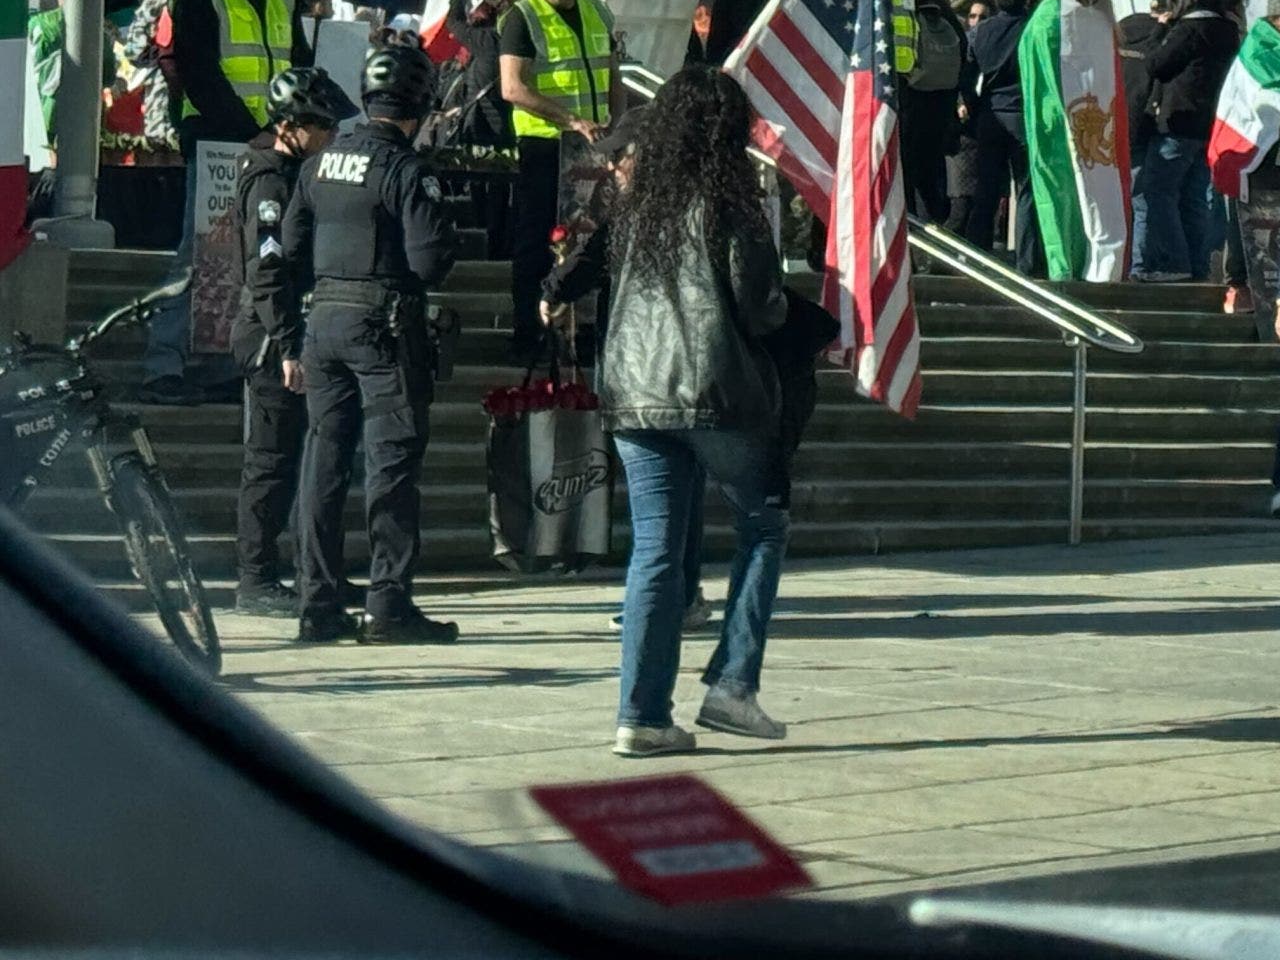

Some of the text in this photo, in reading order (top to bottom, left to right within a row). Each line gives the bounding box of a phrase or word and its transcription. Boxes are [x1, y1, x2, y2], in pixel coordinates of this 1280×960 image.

[208, 163, 235, 180] YOU
[317, 152, 370, 182] POLICE
[15, 415, 55, 437] POLICE
